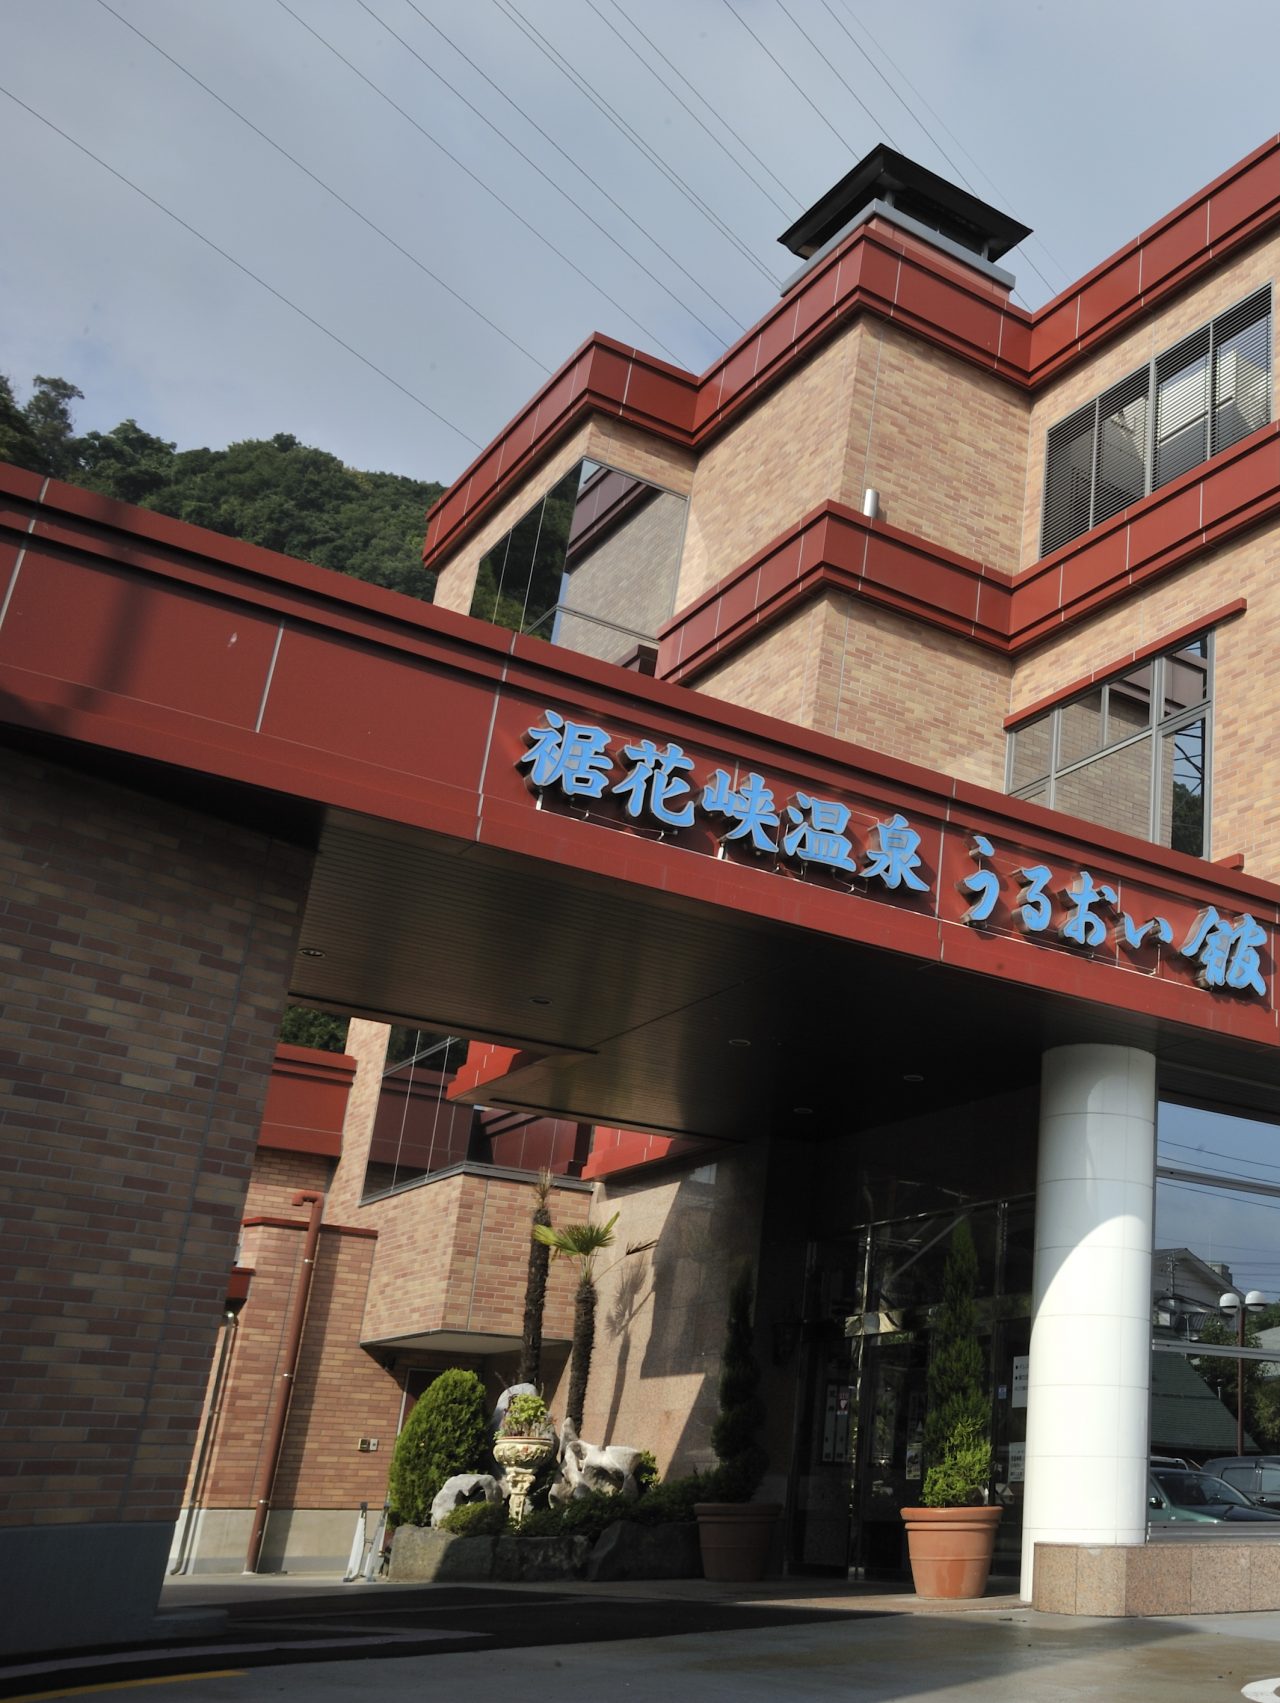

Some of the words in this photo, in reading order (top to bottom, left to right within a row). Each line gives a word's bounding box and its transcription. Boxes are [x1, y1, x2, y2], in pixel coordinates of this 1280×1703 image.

[521, 709, 930, 892] 裾花峡温泉
[957, 836, 1267, 997] うるおい館
